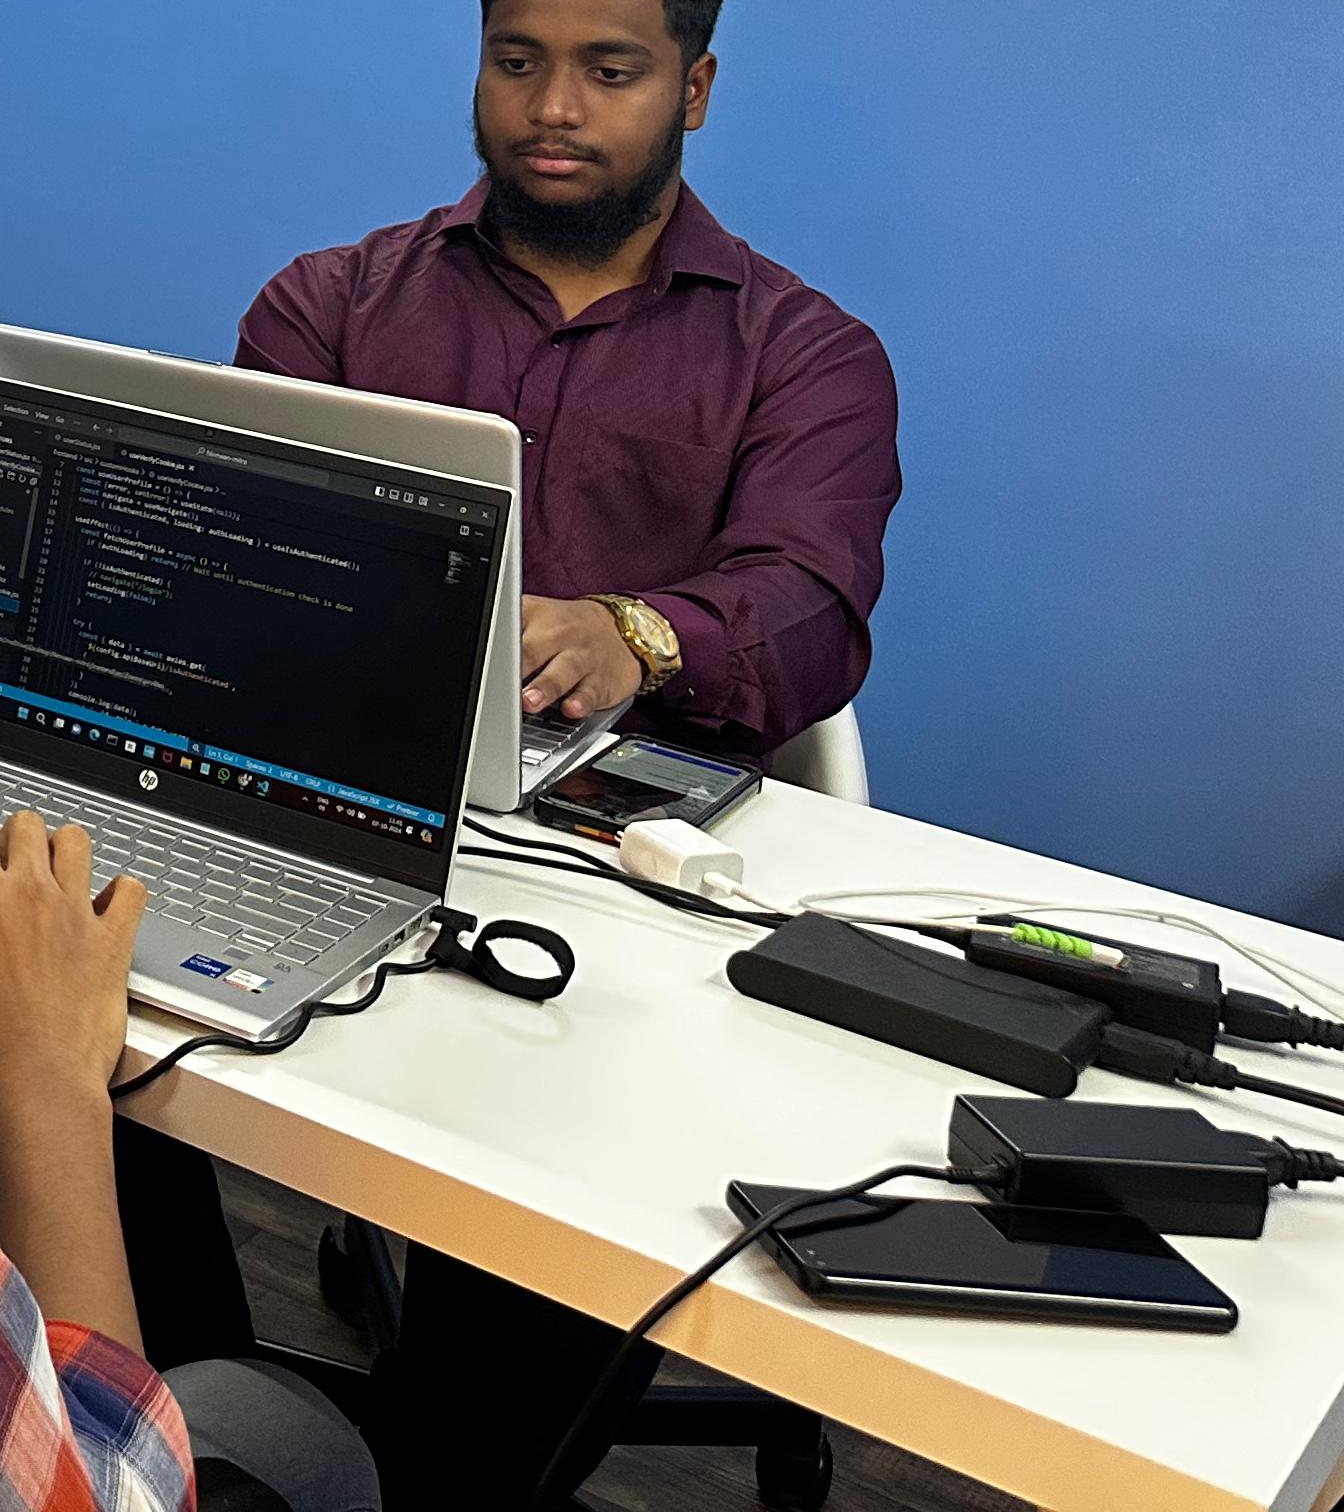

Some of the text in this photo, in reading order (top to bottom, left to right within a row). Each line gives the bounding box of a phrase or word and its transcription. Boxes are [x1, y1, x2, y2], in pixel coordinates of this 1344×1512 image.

[3, 403, 29, 415] Selection
[34, 411, 49, 420] View
[54, 415, 65, 423] Go
[97, 470, 152, 489] useUserProfile
[103, 531, 165, 554] fetchUserProfile
[237, 577, 295, 598] authentication
[140, 769, 157, 789] hp
